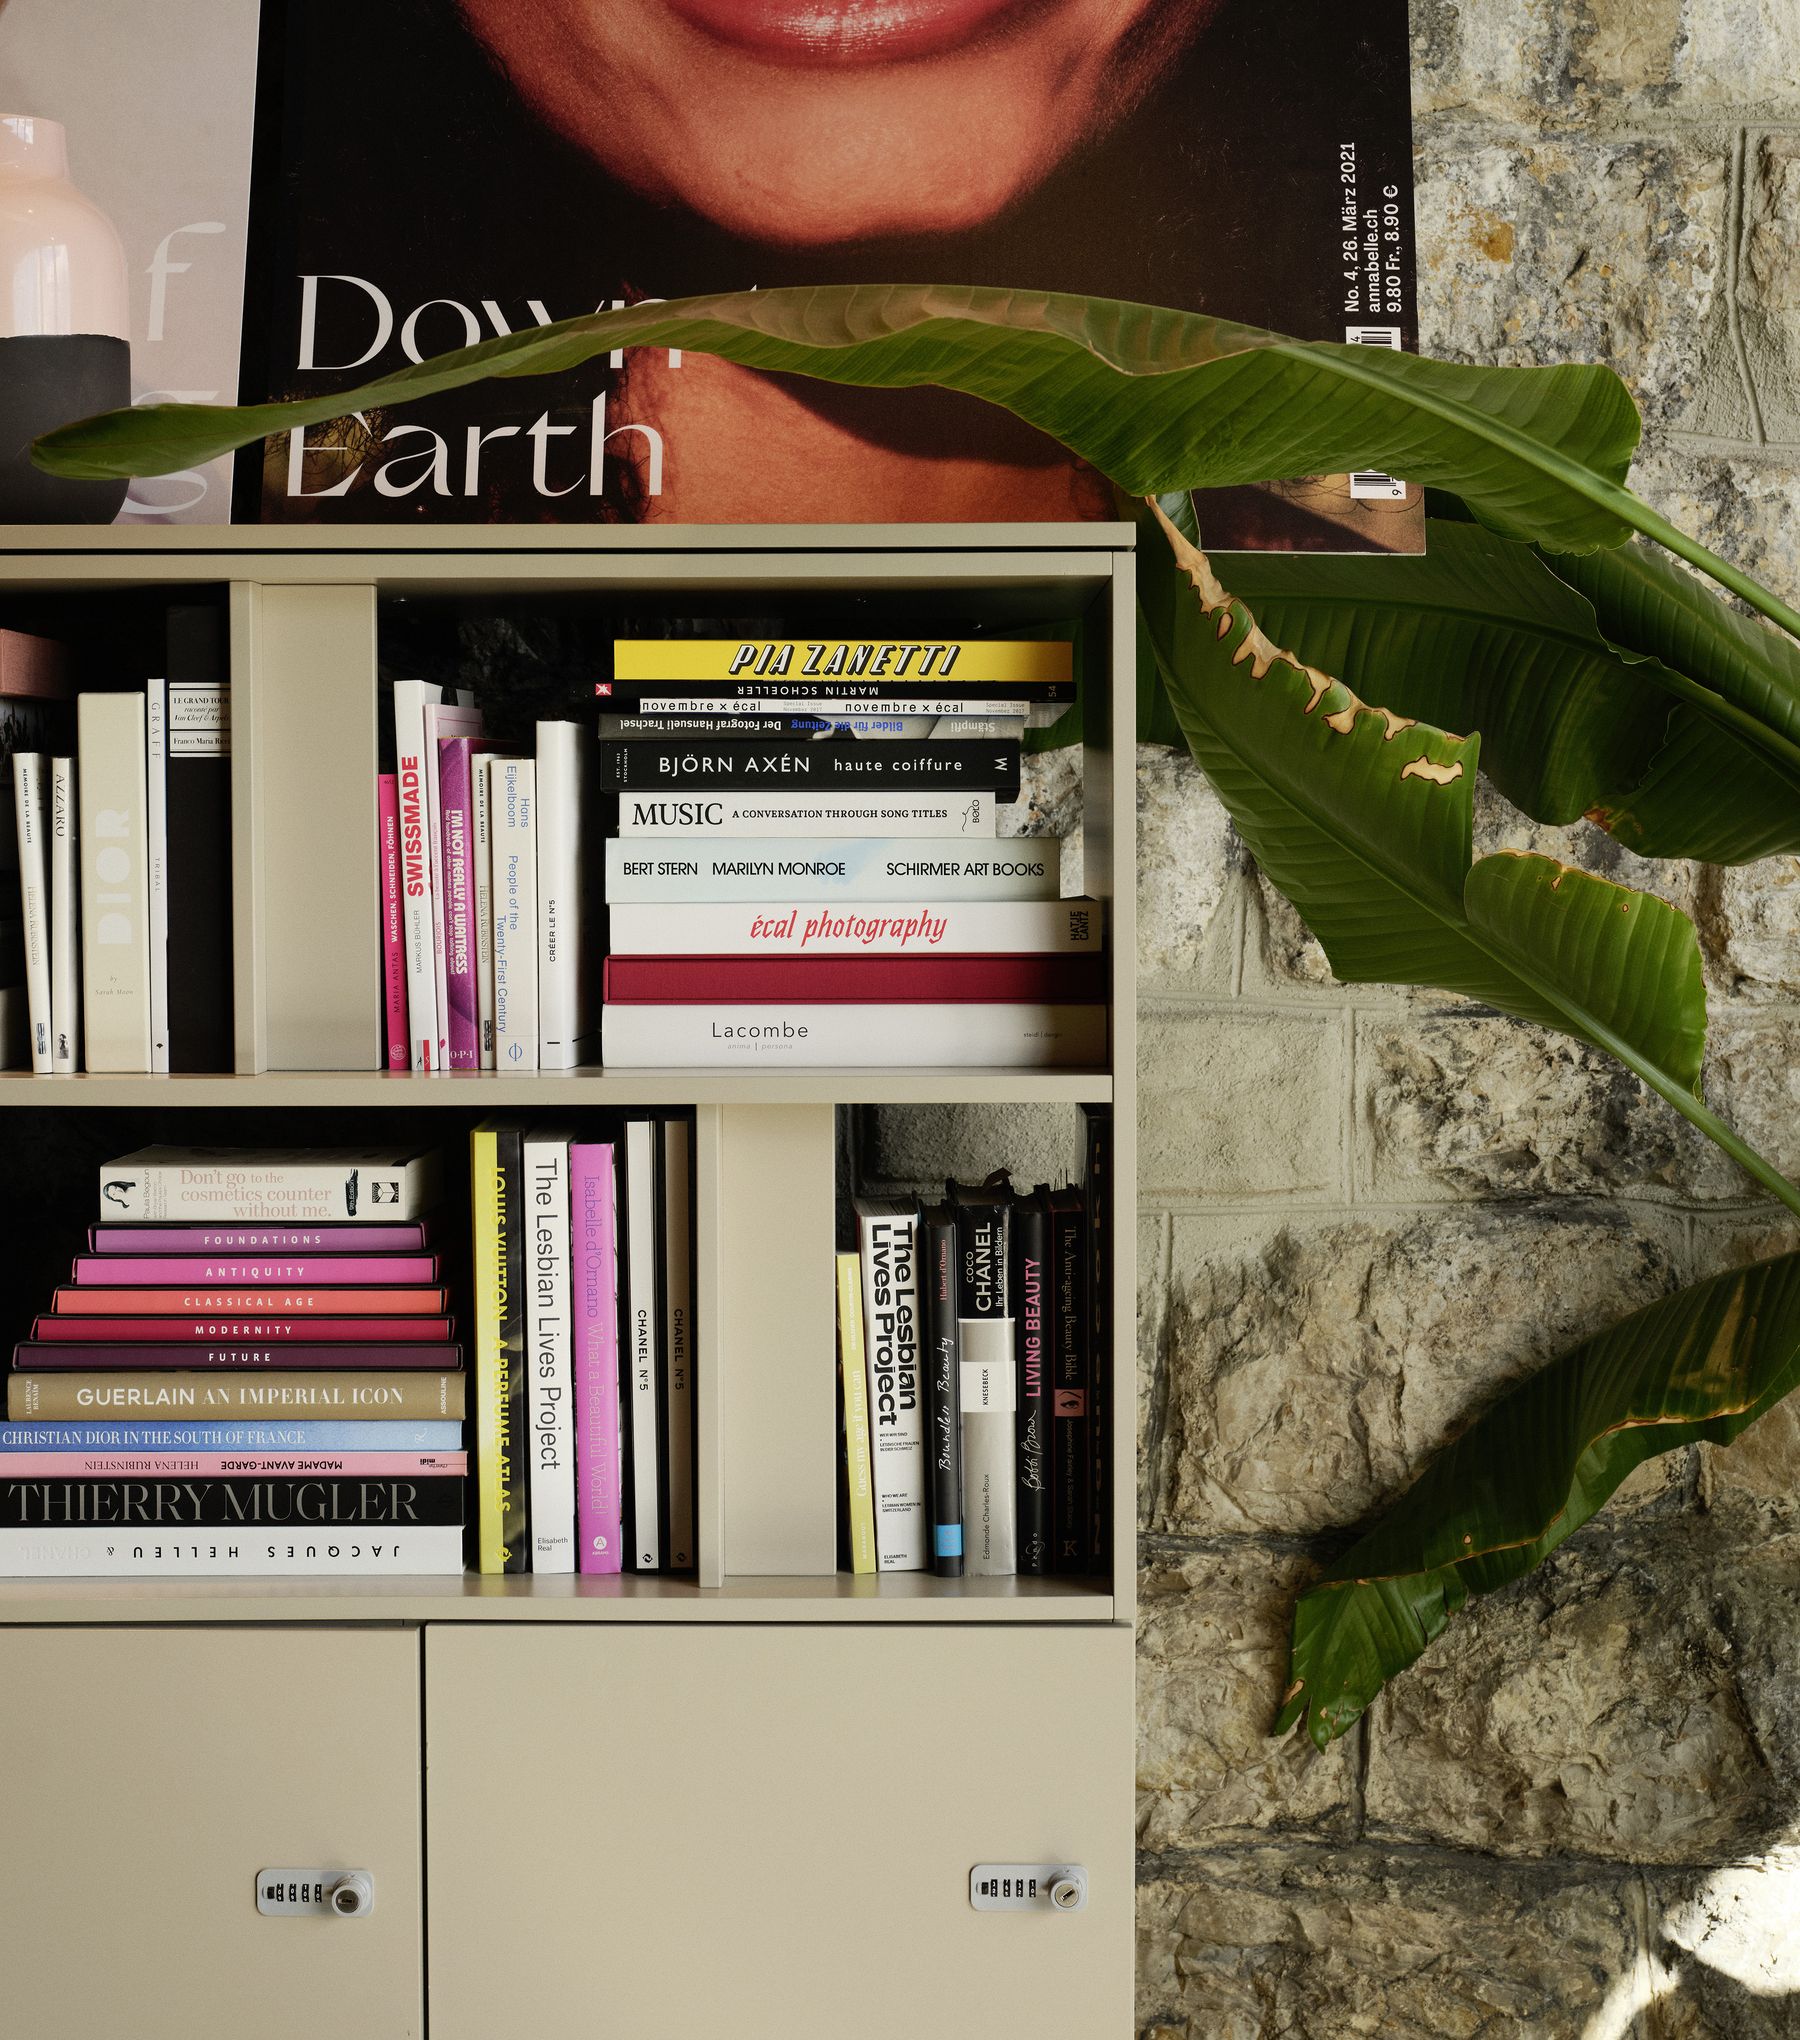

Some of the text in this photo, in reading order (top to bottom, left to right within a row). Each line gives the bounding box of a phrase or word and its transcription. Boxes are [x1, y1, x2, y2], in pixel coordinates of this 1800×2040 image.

[1340, 141, 1361, 312] No. 4, 26. März 2021
[1362, 208, 1381, 313] annabelle.ch
[1382, 184, 1402, 313] 9.80 Fr., 8.90 €
[286, 390, 664, 498] Earth
[728, 643, 961, 676] PIA ZANETTI
[737, 686, 879, 696] MARTIN SCHOELLER
[151, 702, 161, 759] GRAFF
[173, 737, 195, 745] Franco
[196, 737, 214, 745] Maria
[620, 718, 782, 731] Der Fotograf Hansueli Trachsel
[790, 719, 904, 732] Bilder für die Zeitung
[658, 753, 963, 777] BJÖRN AXÉN haute coiffure
[55, 773, 65, 838] AZZARO
[504, 765, 517, 828] Eijkelboom
[520, 797, 530, 828] Hans
[401, 755, 425, 897] SWISSMADE
[631, 802, 949, 826] MUSIC A CONVERSATION THROUGH SONG TITLES
[95, 808, 133, 945] DIOR
[387, 815, 398, 943] WASCHEN, SCHNEIDEN, FÖHNEN
[623, 862, 1045, 877] BERT STERN MARILYN MONROE SCHIRMER ART BOOKS
[451, 809, 468, 975] I'M NOT REALLY A WAITRESS
[508, 855, 519, 930] People of the
[479, 885, 490, 964] HELENA RUBINSTEIN
[750, 908, 948, 948] écal photography
[1069, 910, 1080, 942] HATJE
[1079, 910, 1090, 942] CANTZ
[391, 951, 401, 1014] MARIA ANTAS
[494, 915, 508, 1033] Twenty-First Century
[711, 1020, 810, 1039] Lacombe
[727, 1042, 794, 1051] anima persona
[180, 1168, 285, 1191] Don't go to the
[180, 1186, 333, 1202] cosmetics counter
[233, 1202, 333, 1218] without me.
[204, 1234, 322, 1246] FOUNDATIONS
[205, 1267, 305, 1278] ANTIQUITY
[966, 1250, 974, 1284] COCO
[975, 1221, 991, 1313] CHANEL
[994, 1226, 1004, 1308] Ihr Leben in Bildern
[183, 1297, 315, 1307] CLASSICAL AGE
[535, 1157, 563, 1471] The Lesbian Lives Project
[894, 1220, 917, 1411] The Lesbian
[195, 1325, 293, 1335] MODERNITY
[490, 1166, 512, 1513] LOUIS VUITTON A PERFUME ATLAS
[637, 1309, 648, 1363] CHANEL
[871, 1223, 898, 1426] Lives Project
[1024, 1257, 1042, 1398] LIVING BEAUTY
[208, 1352, 272, 1362] FUTURE
[584, 1175, 609, 1516] Isabelle d'Ornano What a Beautiful World!
[852, 1370, 861, 1391] can
[936, 1336, 955, 1393] Beauty
[76, 1386, 405, 1407] GUERLAIN AN IMPERIAL ICON
[440, 1376, 448, 1415] ASSOULINE
[853, 1390, 864, 1413] you
[2, 1429, 307, 1446] CHRISTIAN DIOR IN THE SOUTH OF FRANCE
[854, 1424, 865, 1444] age
[84, 1460, 343, 1472] MADAME AVANT-GARDE HELENA RUBINSTEIN
[857, 1464, 867, 1497] Guess
[7, 1482, 420, 1523] THIERRY MUGLER
[982, 1473, 990, 1560] Edmonde Charles-Roux
[106, 1546, 116, 1557] &
[133, 1546, 240, 1559] HELLEU
[267, 1545, 401, 1559] JACQUES
[537, 1536, 569, 1546] Elisabeth
[537, 1544, 553, 1552] Real
